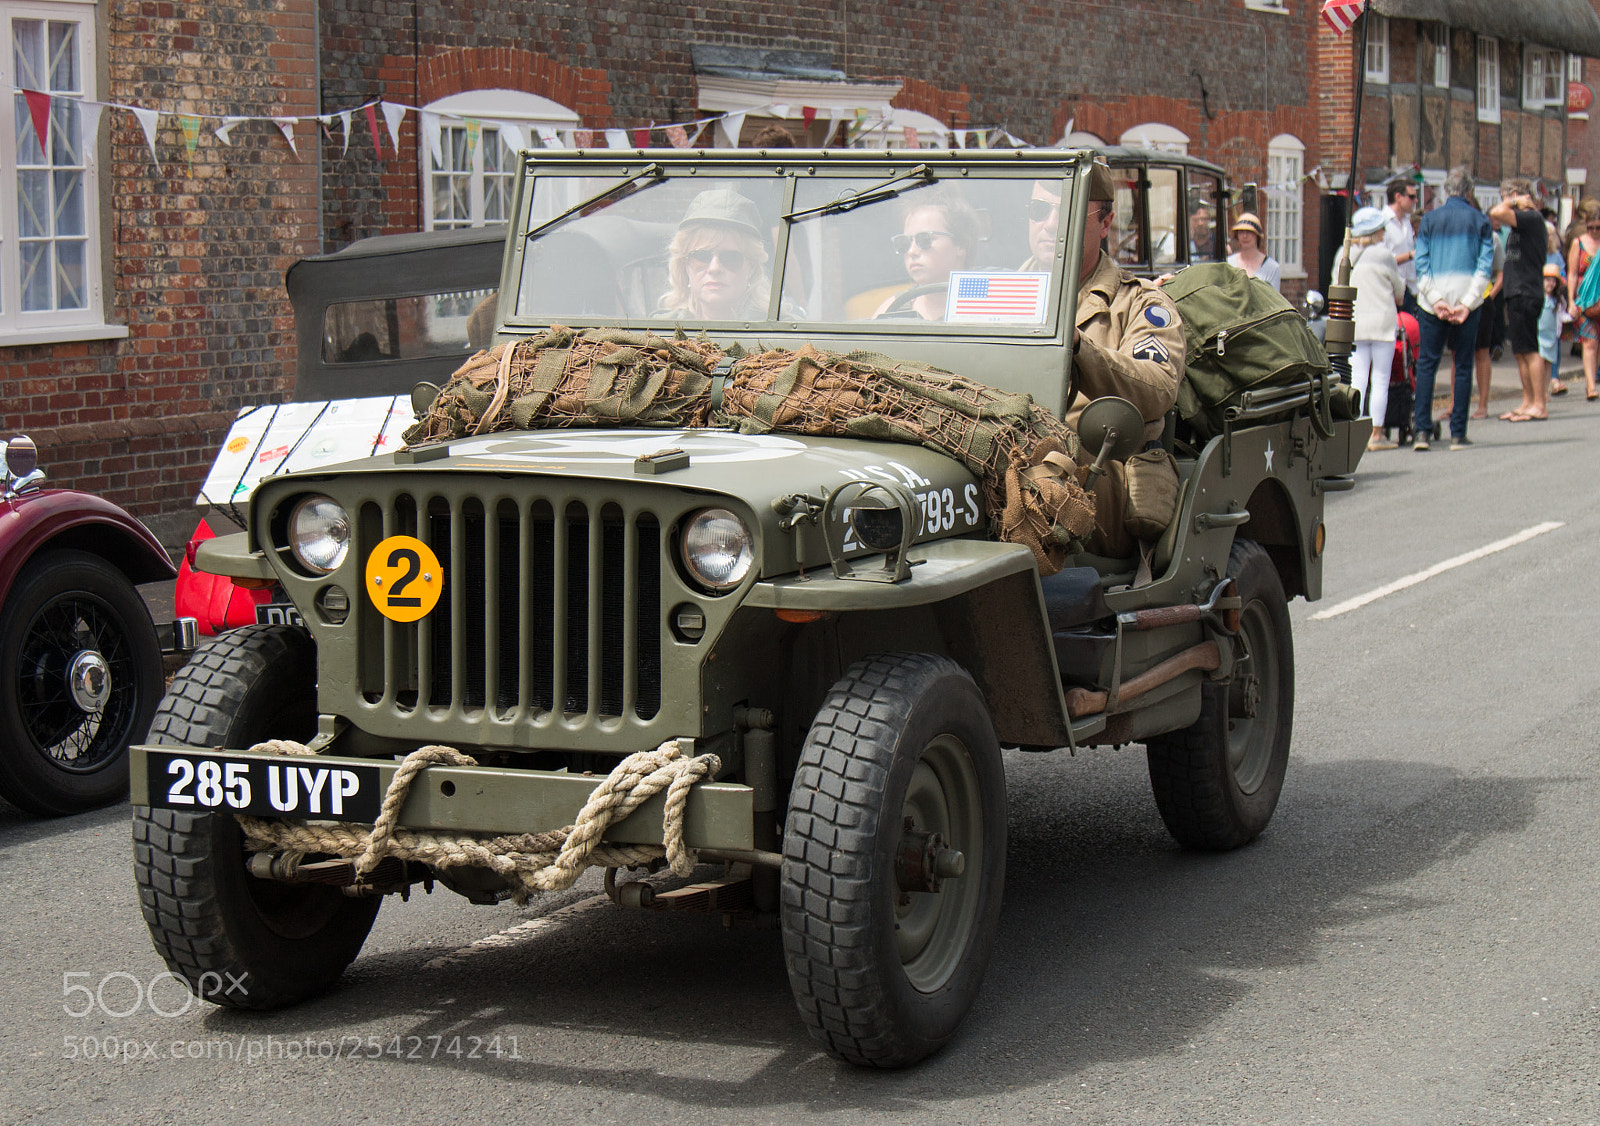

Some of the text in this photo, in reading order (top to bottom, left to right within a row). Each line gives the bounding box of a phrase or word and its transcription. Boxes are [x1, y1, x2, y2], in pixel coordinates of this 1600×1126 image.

[387, 548, 421, 608] 2
[167, 758, 361, 815] 285 UYP
